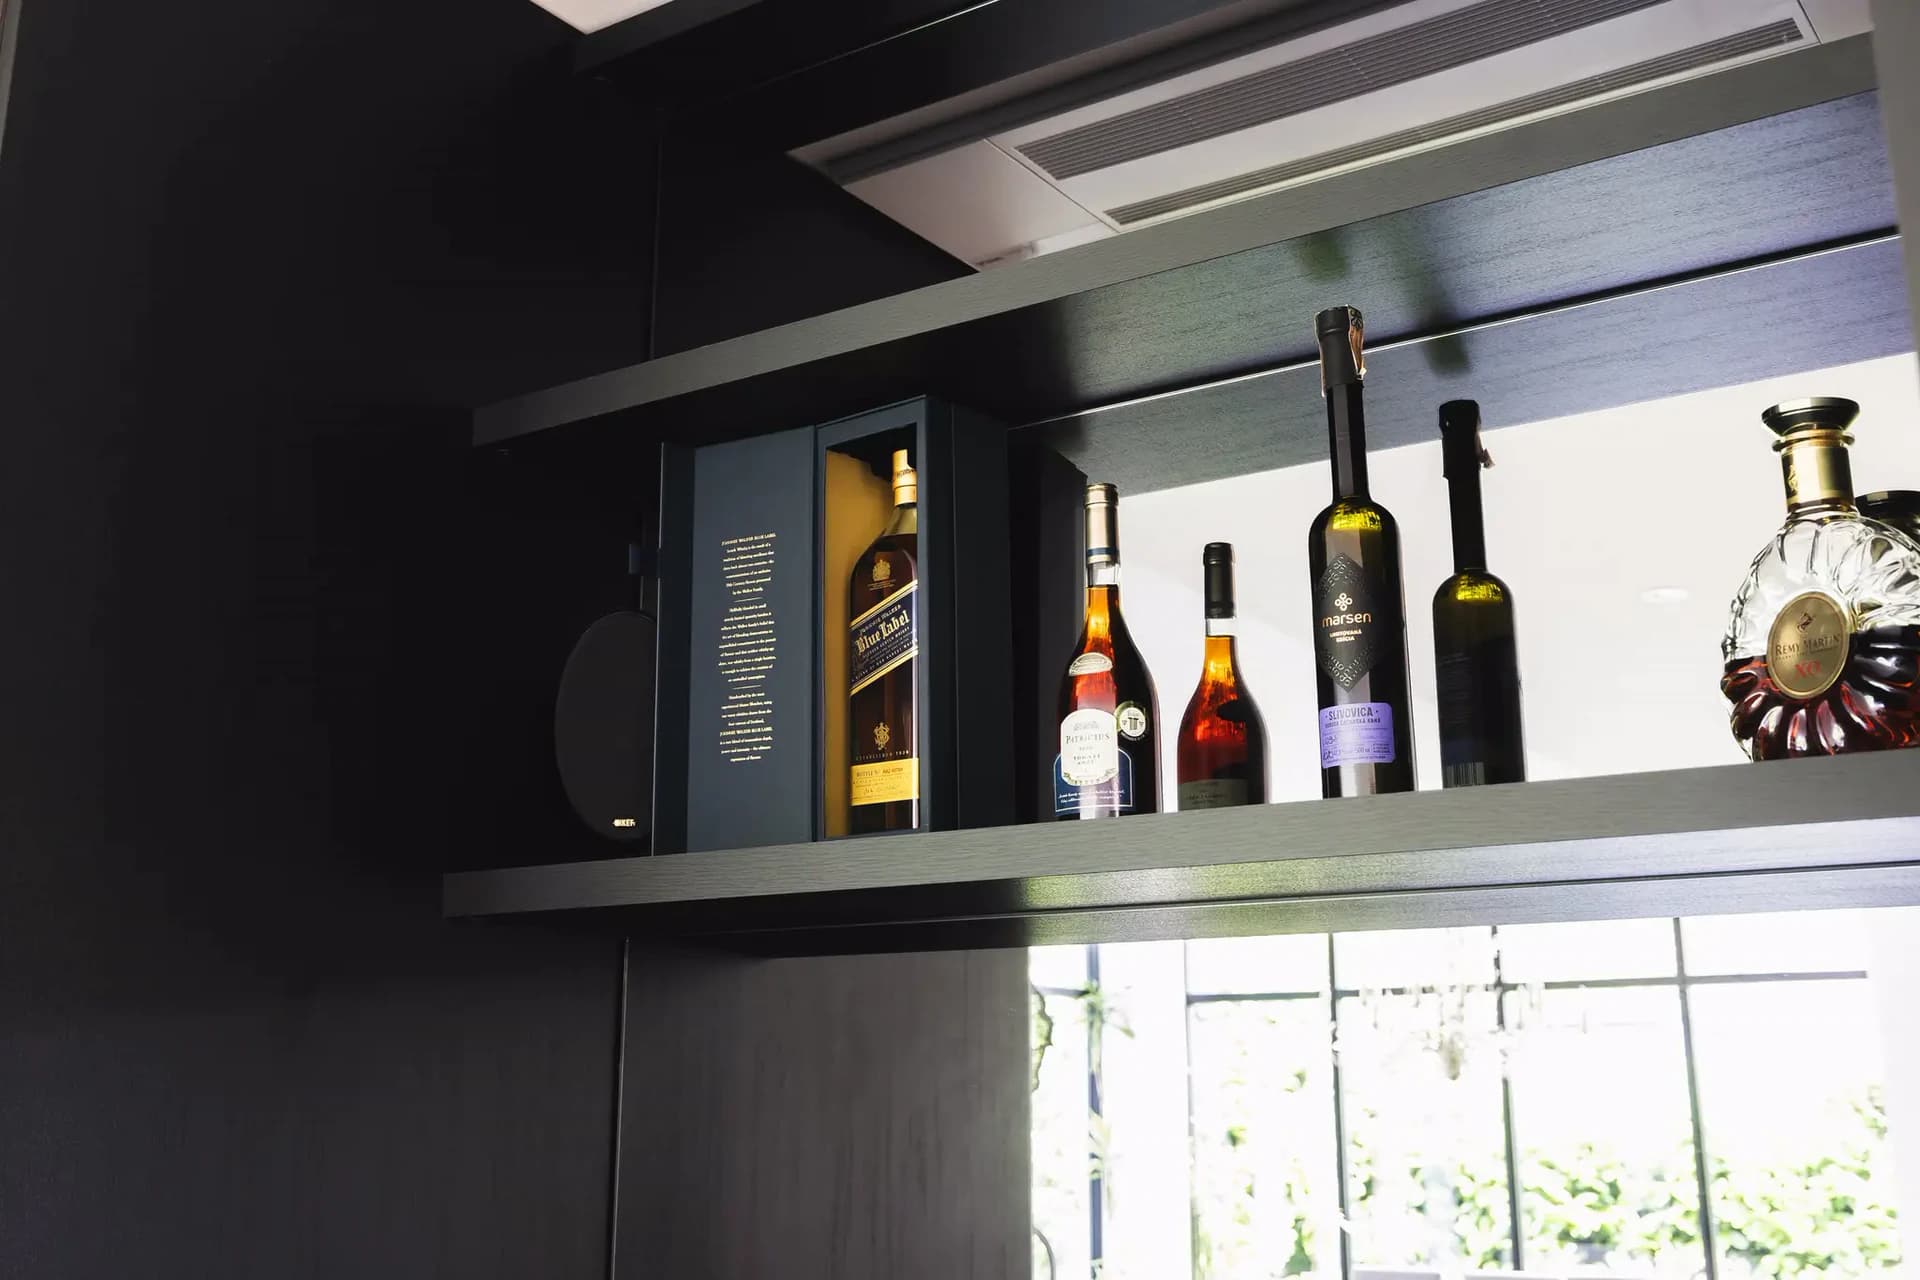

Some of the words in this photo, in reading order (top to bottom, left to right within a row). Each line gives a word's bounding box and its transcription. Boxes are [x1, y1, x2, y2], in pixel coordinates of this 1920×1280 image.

[1322, 612, 1372, 628] marsen
[855, 631, 881, 656] Blue
[879, 609, 910, 640] Label
[1793, 659, 1822, 681] XO
[1328, 707, 1374, 721] SLIVOVICA
[1065, 733, 1111, 745] PATRICIUS
